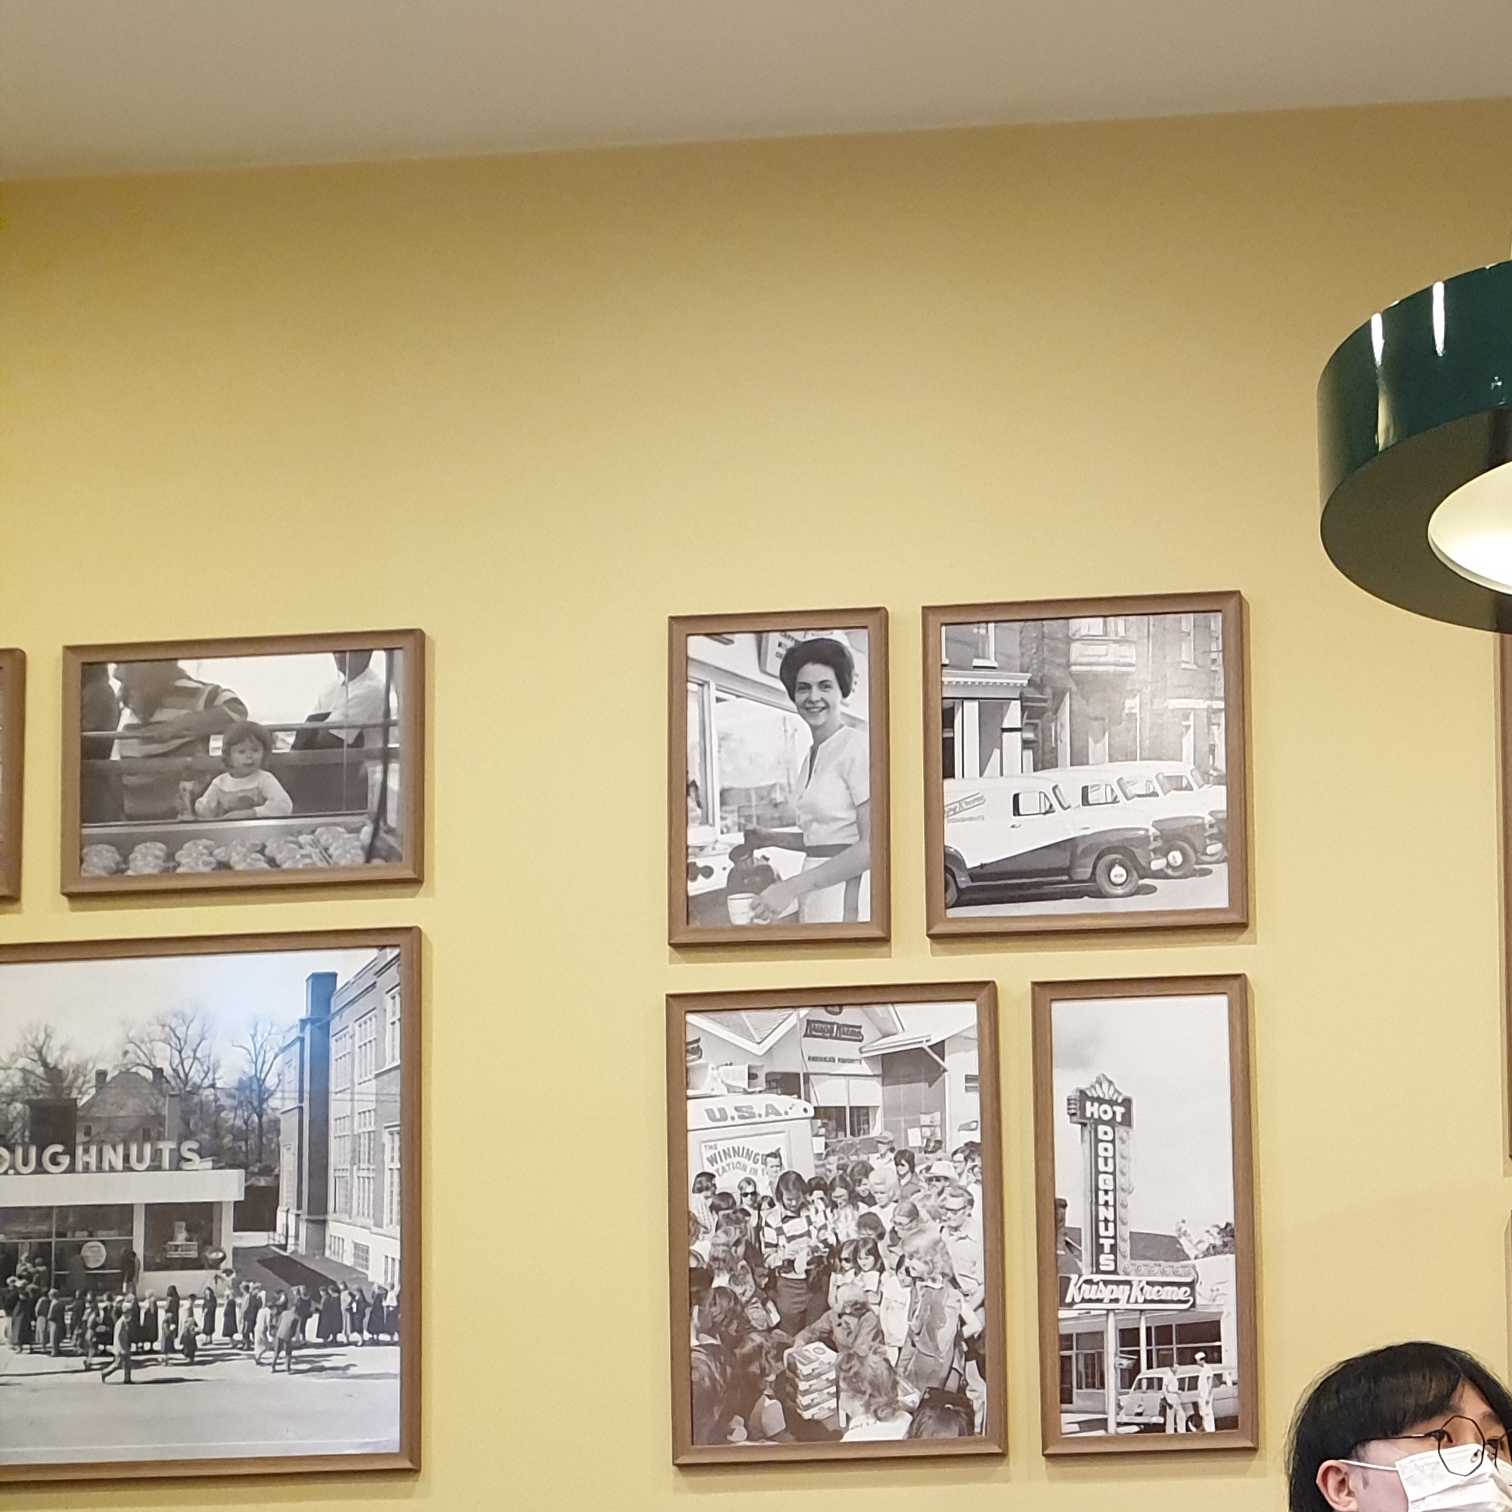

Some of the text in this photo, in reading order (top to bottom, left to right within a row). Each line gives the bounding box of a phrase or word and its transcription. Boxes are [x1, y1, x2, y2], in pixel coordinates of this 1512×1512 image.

[705, 1103, 789, 1122] U.S.A.
[1085, 1101, 1126, 1123] HOT
[704, 1143, 718, 1152] THE
[1097, 1124, 1116, 1272] DOUGHNUTS
[1065, 1274, 1194, 1309] Krispy Kreme
